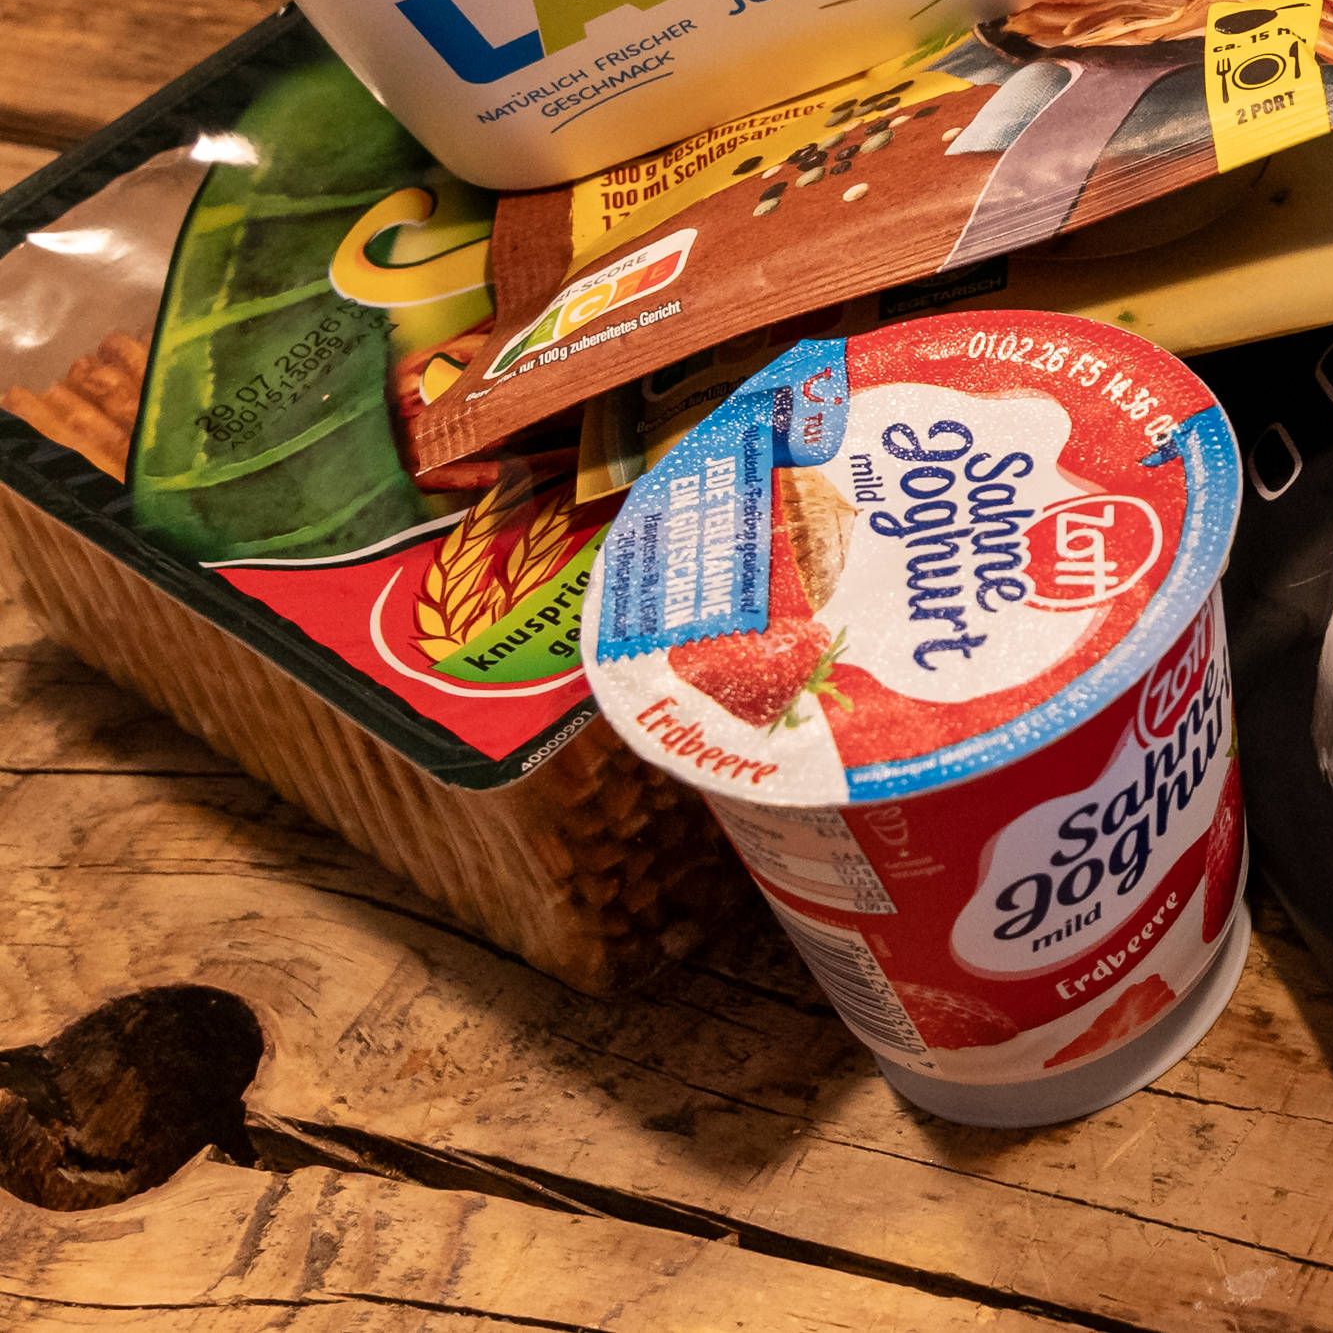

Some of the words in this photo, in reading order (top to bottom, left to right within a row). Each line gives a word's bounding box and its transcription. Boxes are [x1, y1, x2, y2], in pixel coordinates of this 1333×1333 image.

[477, 69, 590, 126] NATÜRLICH
[593, 17, 700, 70] FRISCHER
[541, 51, 676, 120] GESCHMACK
[1236, 109, 1248, 126] 2
[1250, 90, 1296, 120] PORT
[601, 166, 641, 187] 300
[601, 189, 639, 211] 100
[643, 179, 671, 202] ml
[569, 317, 639, 356] zubereitetes
[638, 299, 683, 328] Gericht
[886, 276, 1003, 316] VEGETARISCH
[196, 316, 342, 433] 29.07.2026
[968, 332, 1069, 372] 01.02.26
[1068, 353, 1107, 388] F5
[802, 410, 824, 445] TUI
[669, 477, 700, 511] EIN
[704, 457, 737, 502] JEDE
[849, 452, 874, 504] mild
[701, 501, 736, 617] TEILNAHME
[871, 420, 989, 672] Joghurt
[965, 451, 1034, 614] Sahne
[1056, 504, 1121, 601] Zott
[664, 511, 697, 629] GUTSCHEIN
[521, 709, 593, 773] 40000901
[635, 696, 779, 784] Erdbeere
[1051, 662, 1216, 866] Sahne
[1032, 902, 1102, 953] mild
[1056, 889, 1180, 1002] Erdbeere
